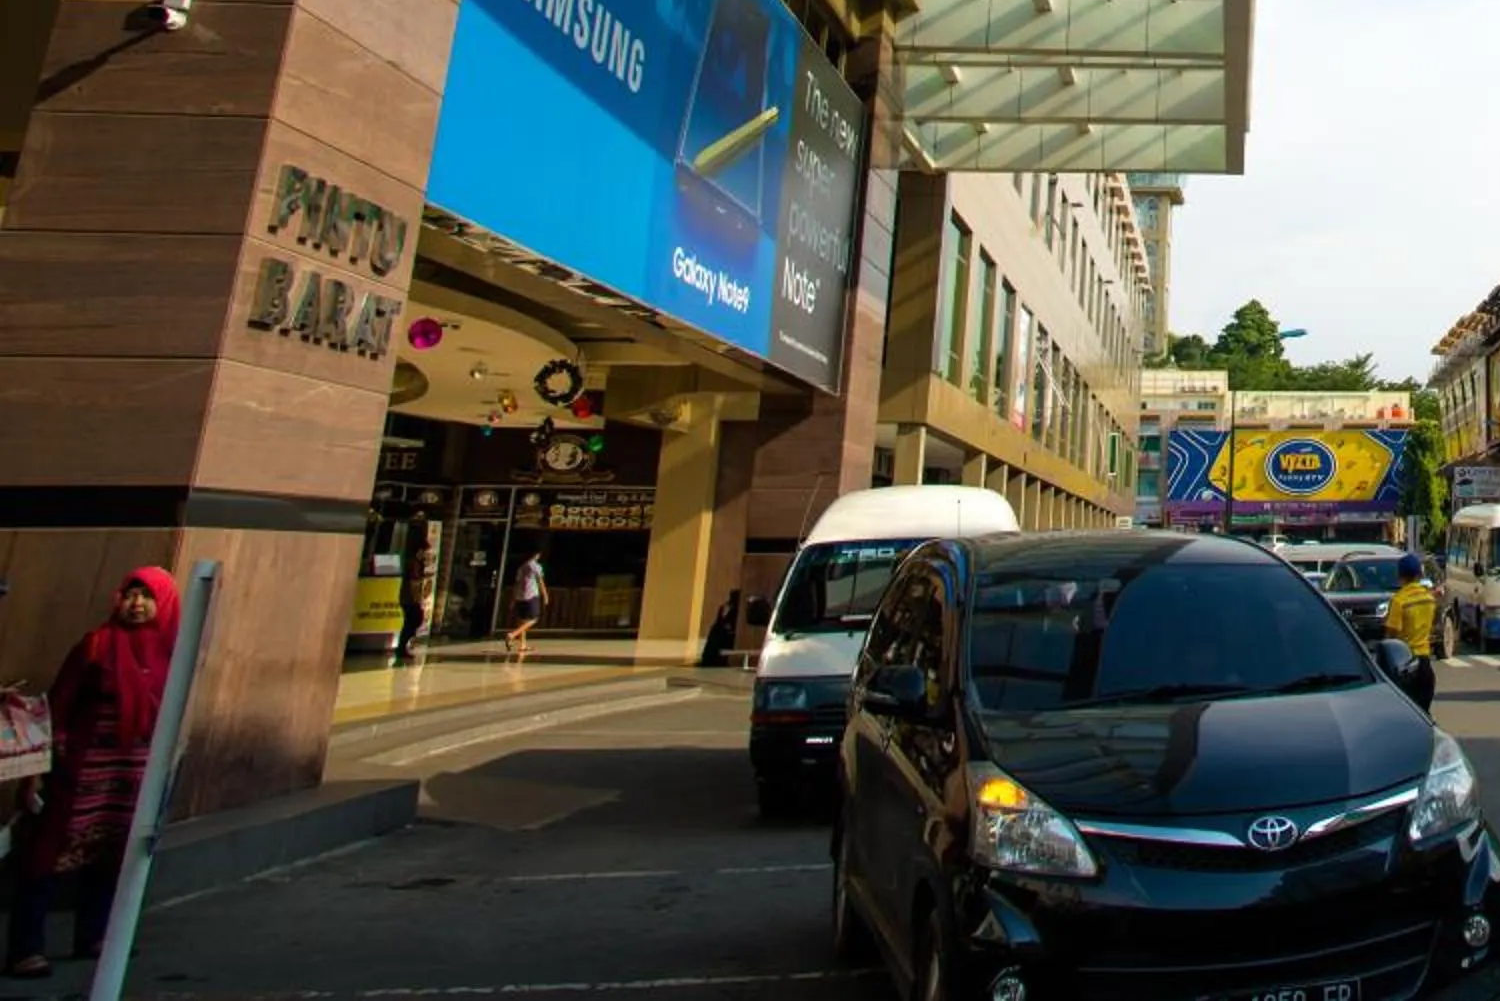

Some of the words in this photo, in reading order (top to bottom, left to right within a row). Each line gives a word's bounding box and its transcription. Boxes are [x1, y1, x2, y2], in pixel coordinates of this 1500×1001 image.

[804, 70, 829, 130] The
[829, 111, 860, 160] new
[795, 139, 835, 197] super
[264, 164, 407, 276] PINTU
[248, 258, 401, 361] BARAT
[673, 246, 718, 306] Galaxy
[717, 271, 750, 314] Note9
